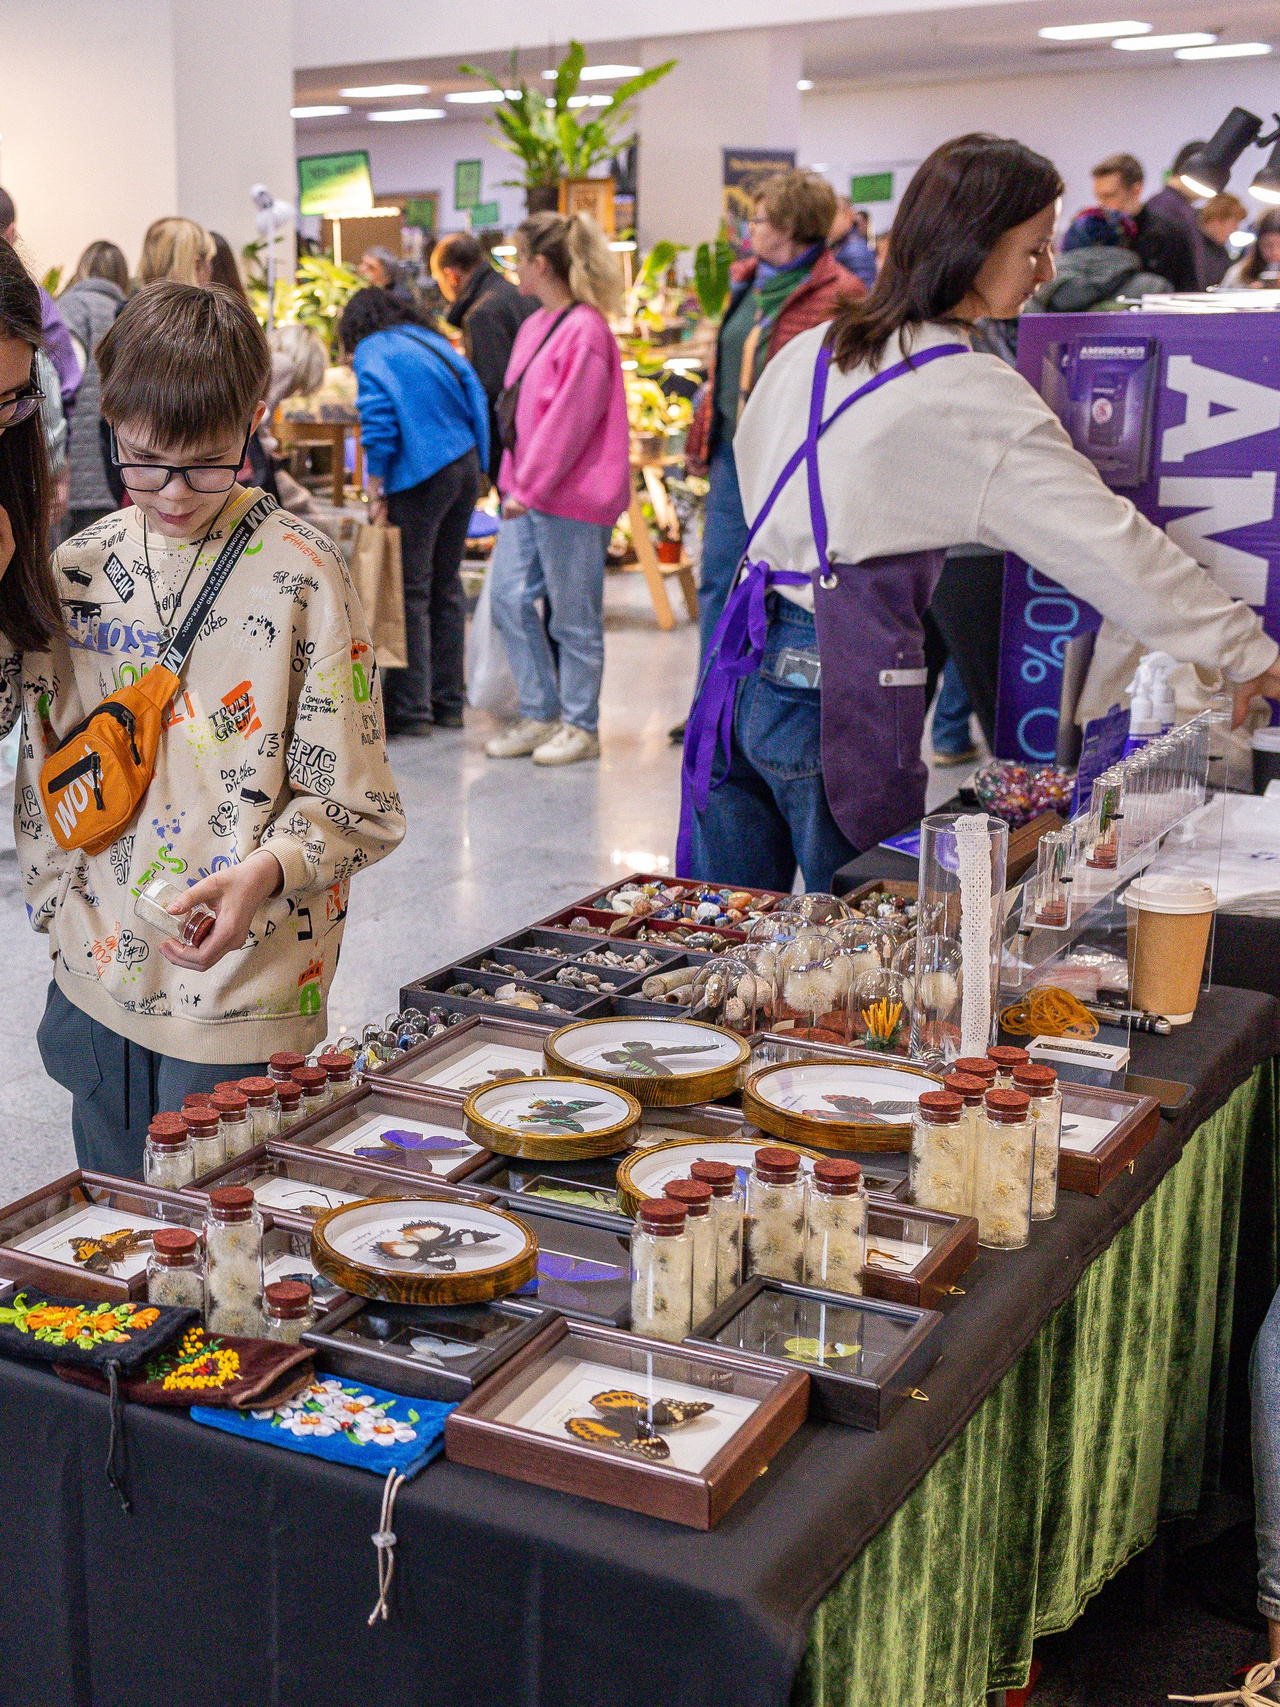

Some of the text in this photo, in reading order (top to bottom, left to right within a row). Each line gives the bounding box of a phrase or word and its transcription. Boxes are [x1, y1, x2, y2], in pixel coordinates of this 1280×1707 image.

[105, 556, 137, 600] BREAK
[208, 692, 251, 728] TRULY
[215, 706, 252, 741] GREAT
[266, 732, 281, 758] RUN
